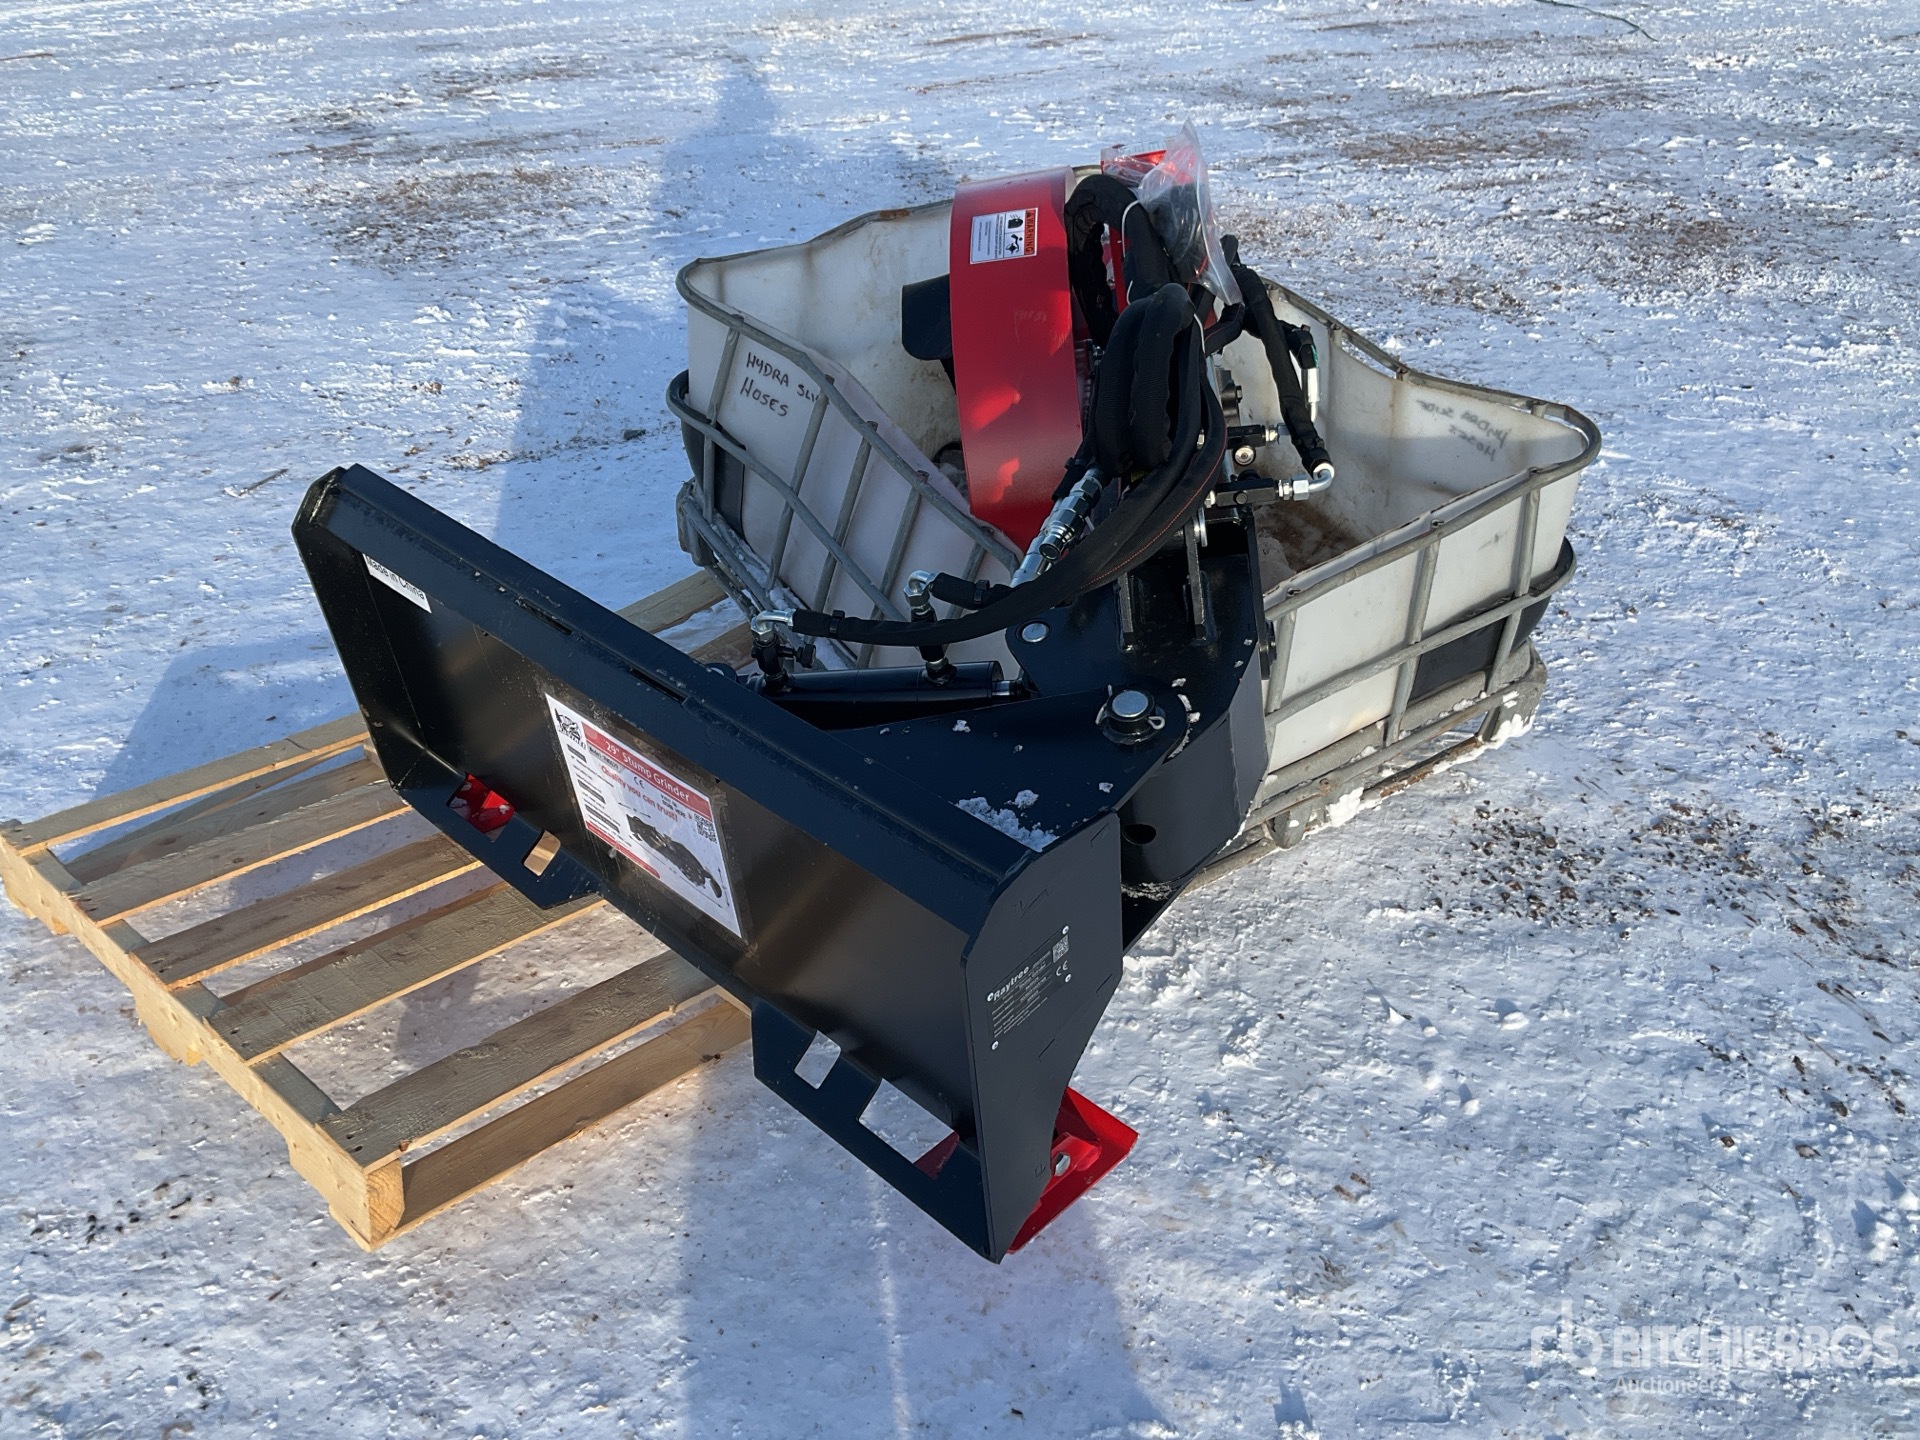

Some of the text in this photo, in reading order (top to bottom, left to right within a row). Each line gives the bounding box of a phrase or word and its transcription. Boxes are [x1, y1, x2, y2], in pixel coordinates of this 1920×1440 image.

[1025, 217, 1034, 253] WARNING
[746, 351, 789, 387] HYDRA
[740, 377, 789, 417] HOSES
[601, 765, 627, 789] Quality
[627, 783, 641, 798] you
[642, 795, 656, 808] can
[656, 802, 678, 822] trust!
[622, 752, 652, 779] Stump
[653, 773, 690, 802] Grinder
[993, 966, 1030, 1001] Raytree
